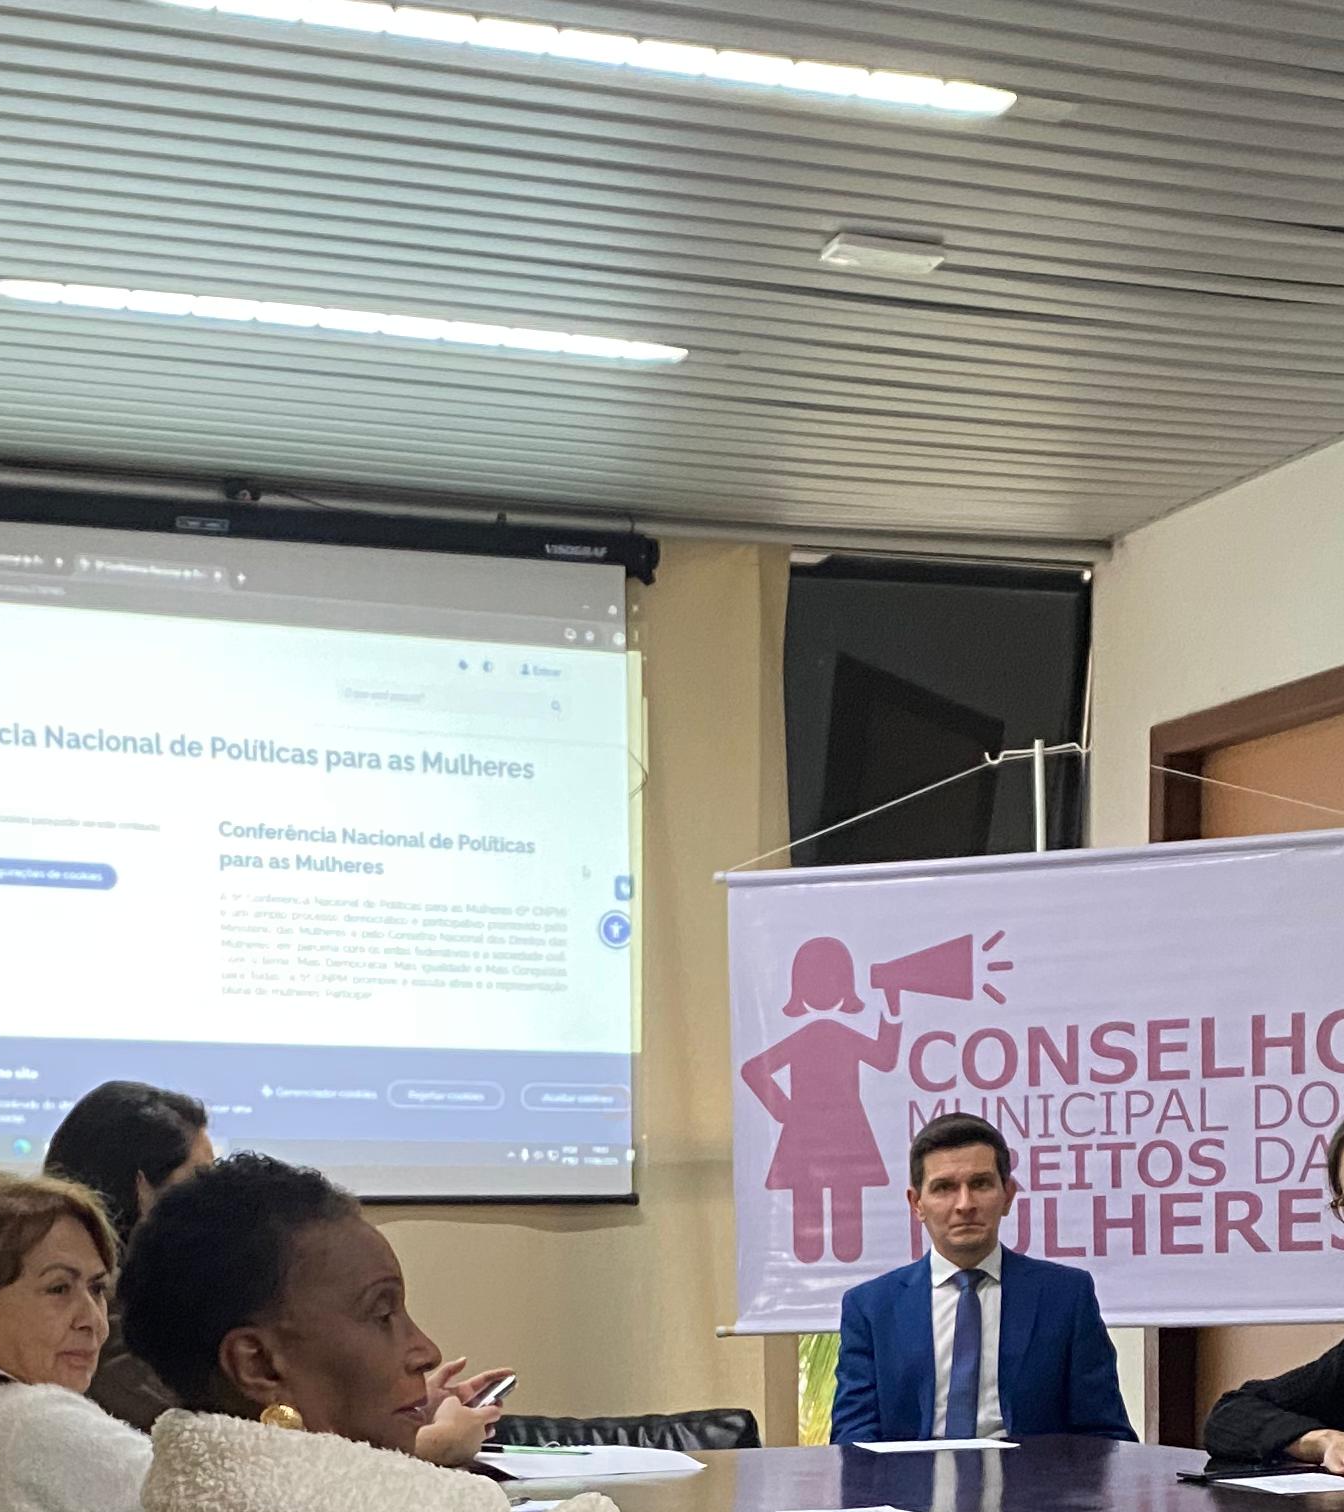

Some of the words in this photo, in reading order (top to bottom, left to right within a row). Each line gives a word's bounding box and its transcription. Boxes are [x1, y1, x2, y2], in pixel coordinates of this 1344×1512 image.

[45, 725, 164, 757] Nacional
[169, 733, 203, 758] de
[210, 735, 320, 767] Políticas
[325, 748, 383, 773] para
[387, 752, 416, 773] as
[421, 750, 536, 781] Mulheres
[218, 820, 338, 845] Conferência
[342, 827, 426, 849] Nacional
[429, 832, 454, 850] de
[458, 833, 537, 855] Políticas
[219, 853, 264, 872] para
[268, 855, 291, 871] as
[295, 853, 385, 876] Mulheres
